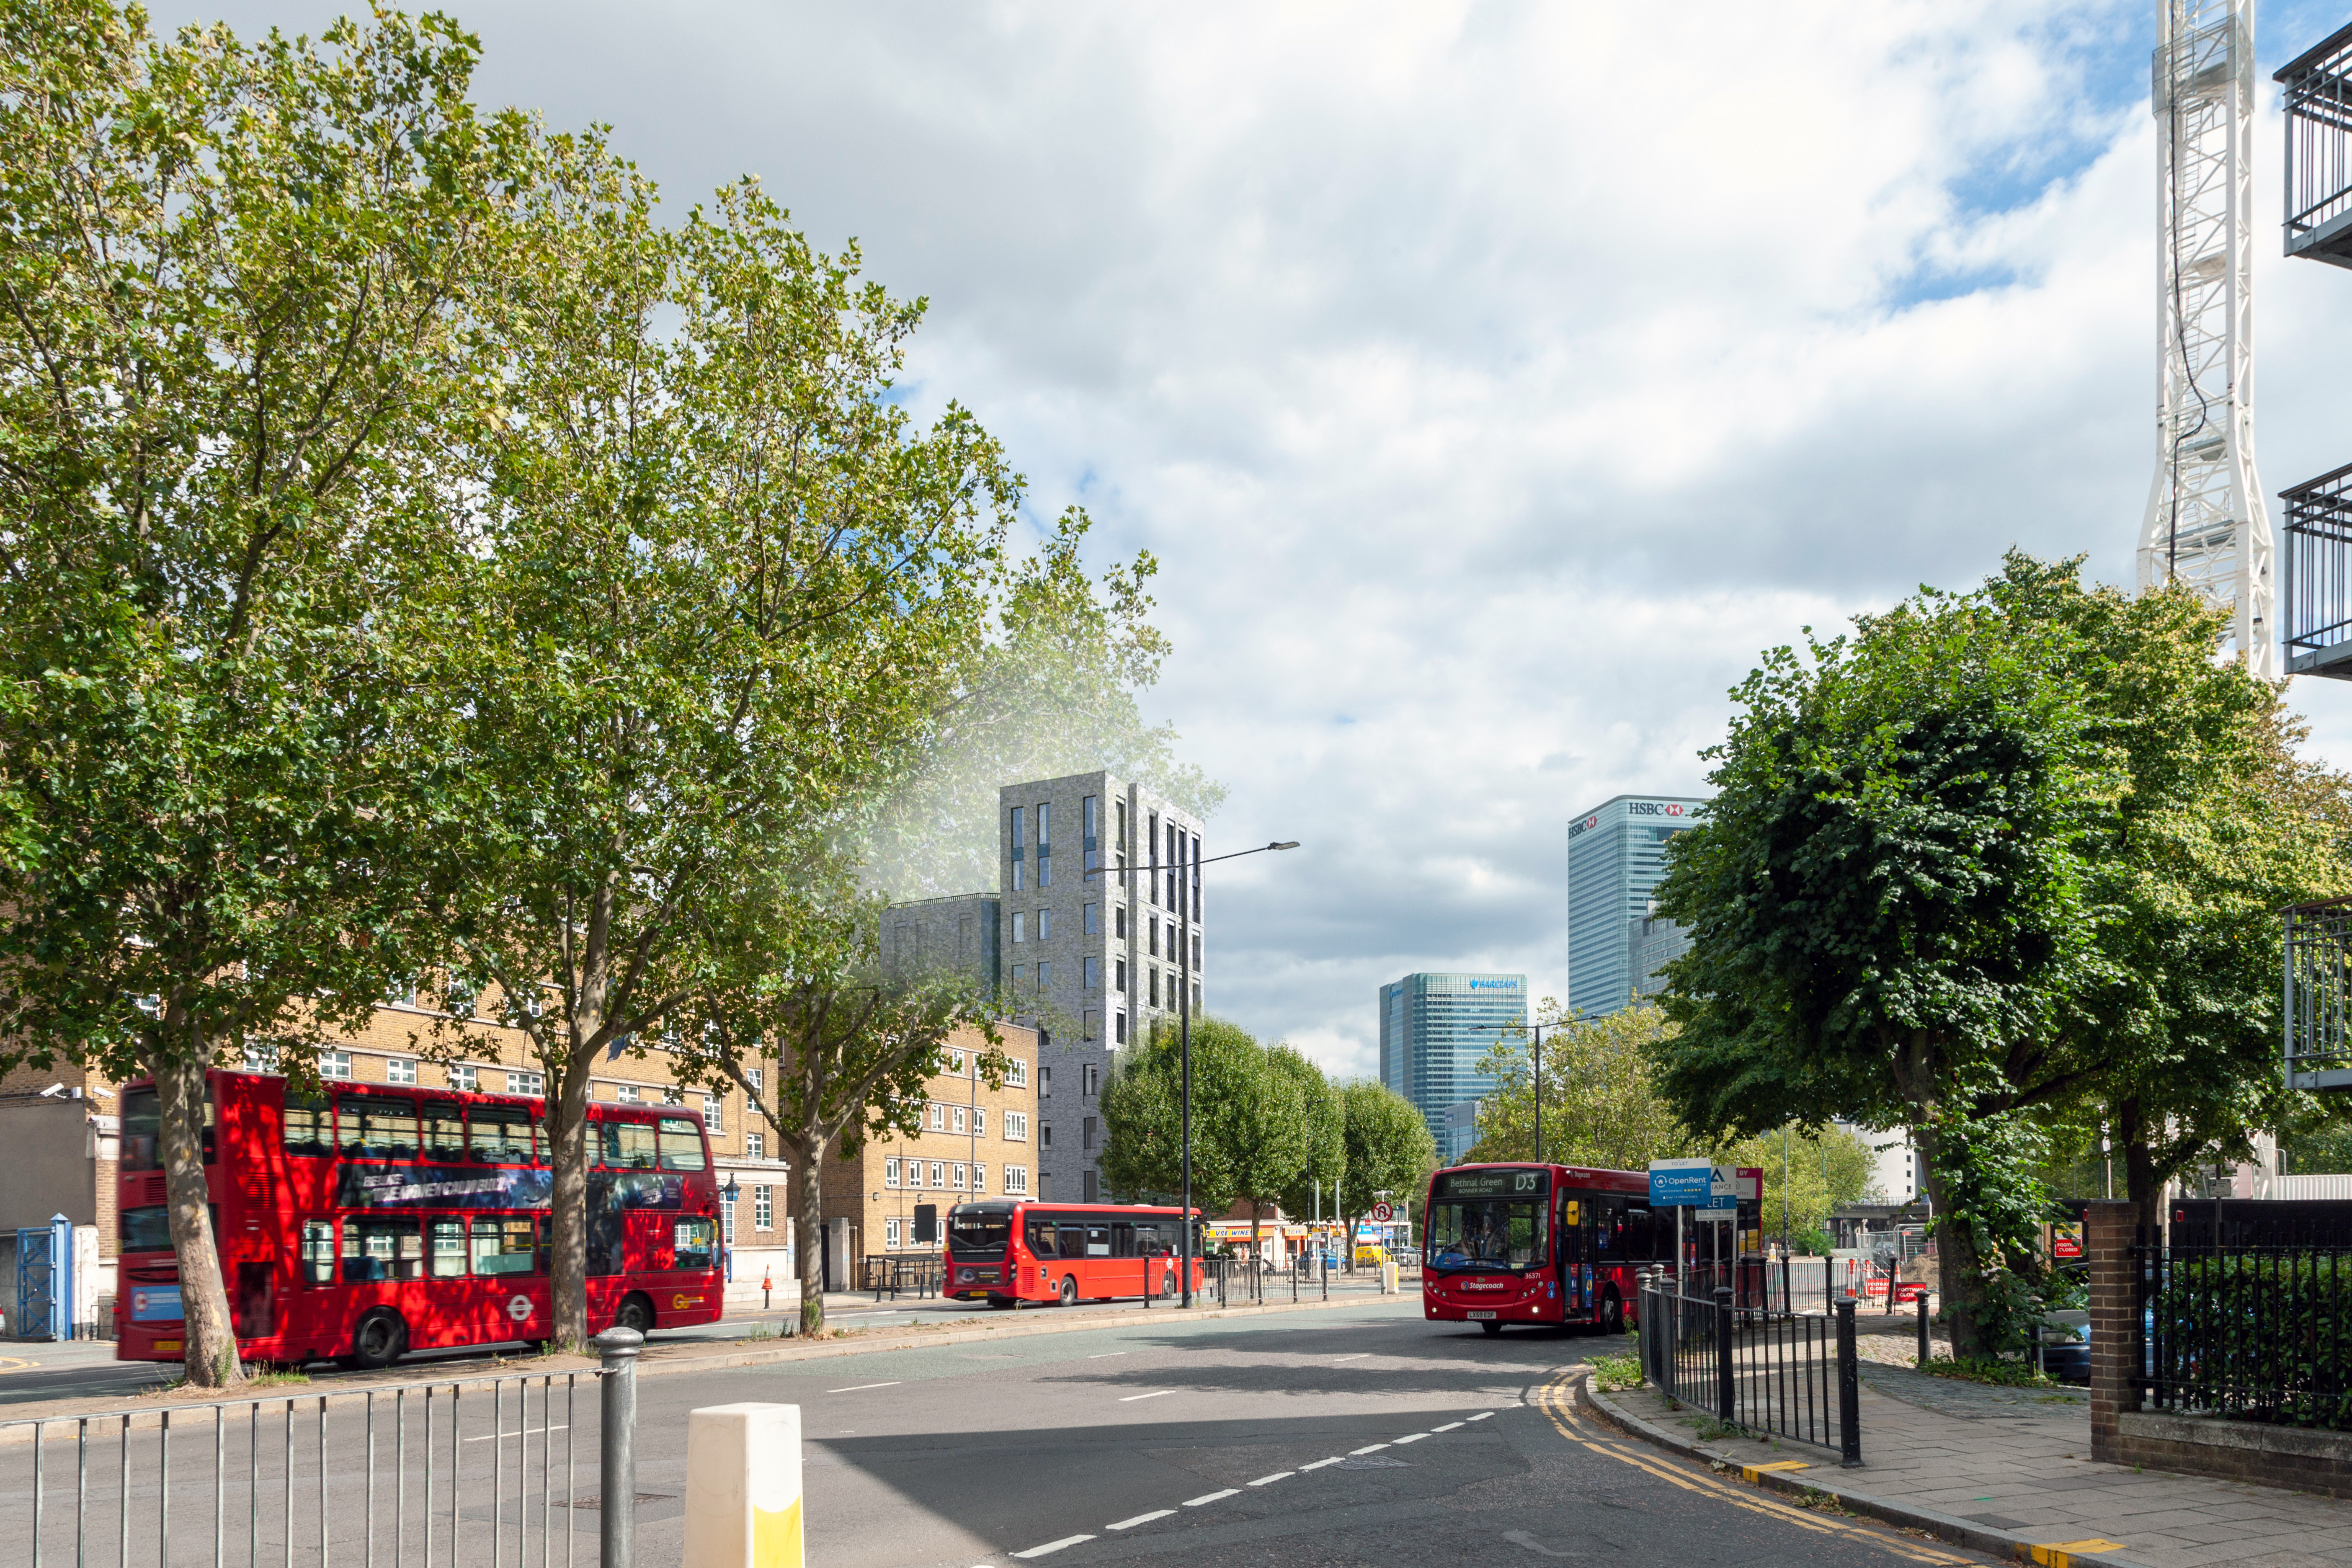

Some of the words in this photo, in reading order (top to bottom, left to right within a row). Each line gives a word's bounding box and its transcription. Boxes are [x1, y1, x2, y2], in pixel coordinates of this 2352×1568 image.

[1629, 802, 1663, 815] HSBC
[1568, 820, 1586, 838] HSBC
[1450, 1178, 1478, 1187] Bethnal
[1480, 1177, 1502, 1186] Green
[1516, 1174, 1536, 1190] D3
[1470, 1282, 1504, 1290] Stagecoach
